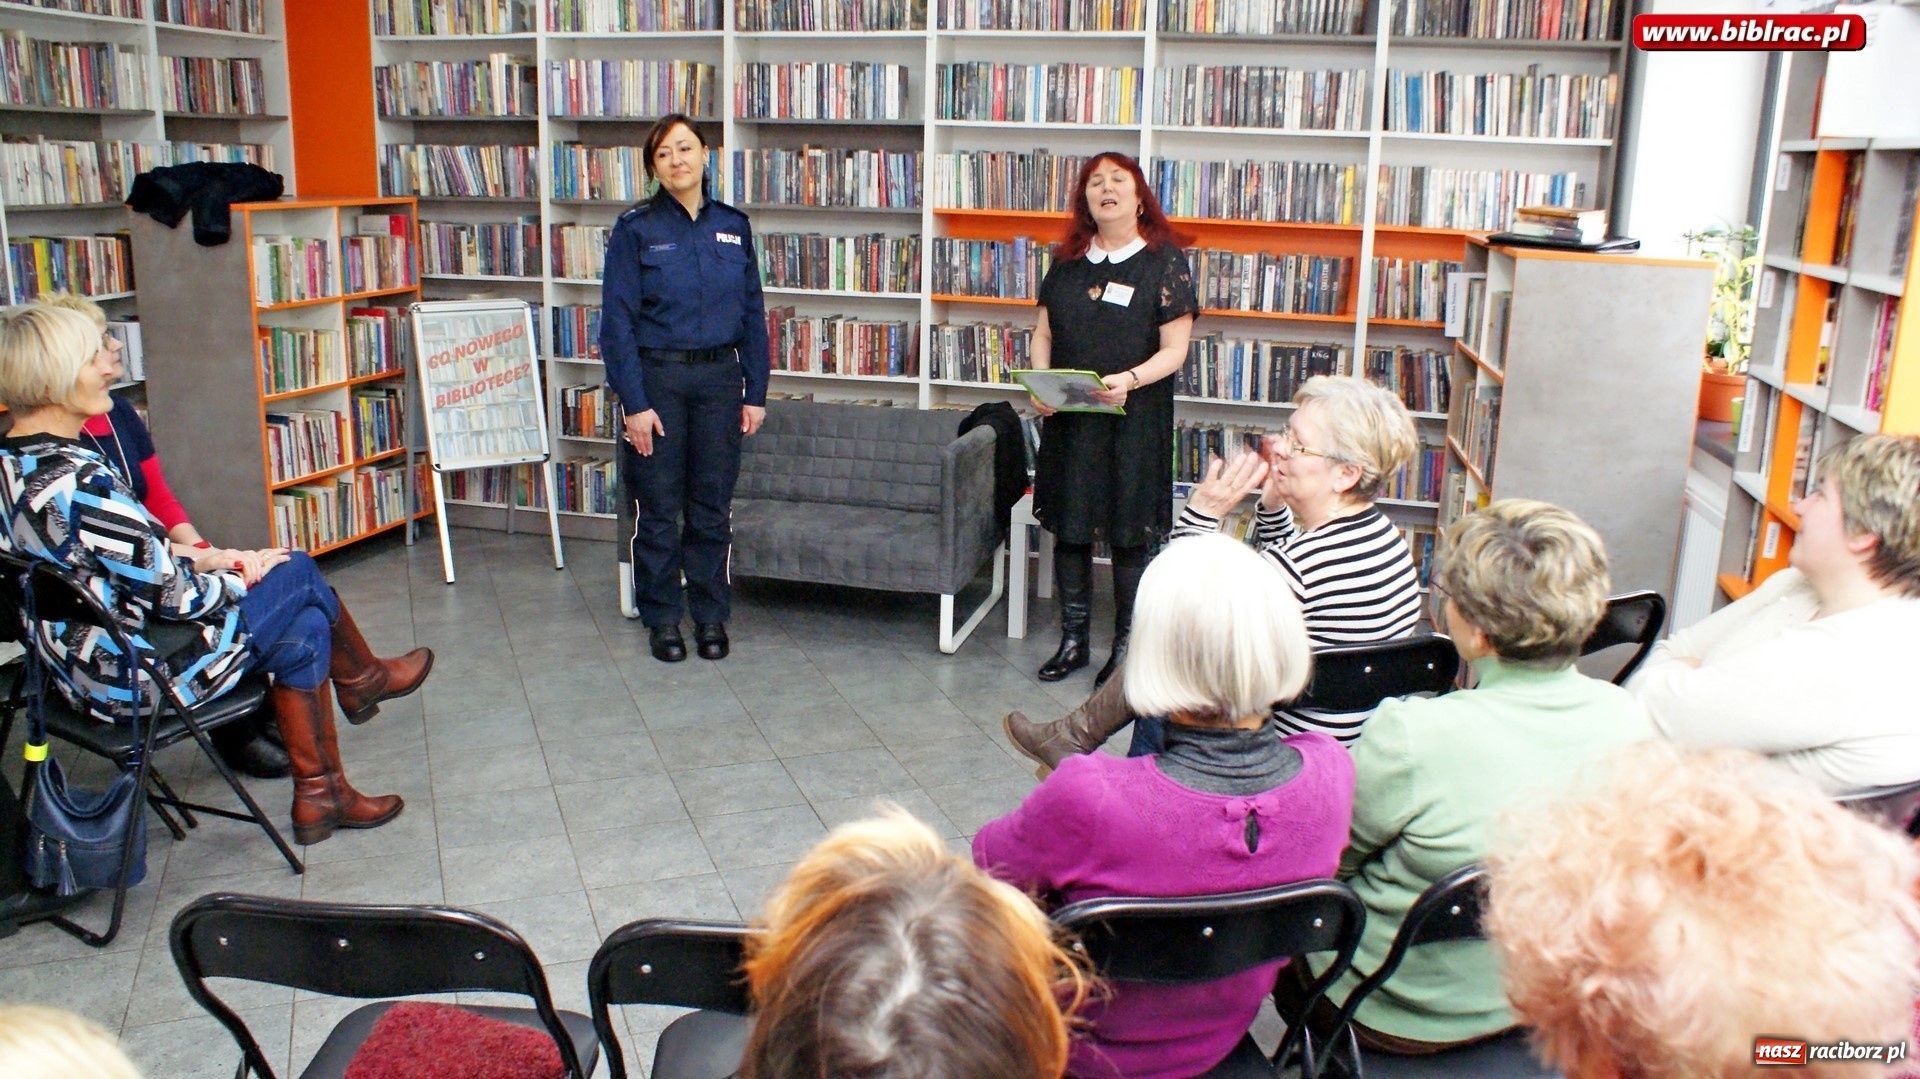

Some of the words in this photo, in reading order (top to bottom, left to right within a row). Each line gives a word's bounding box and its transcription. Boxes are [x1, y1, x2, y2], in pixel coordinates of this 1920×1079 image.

[427, 350, 451, 370] CO
[454, 323, 525, 361] NOWEGO
[473, 357, 489, 375] W
[435, 362, 531, 410] BIBLIOTECE?
